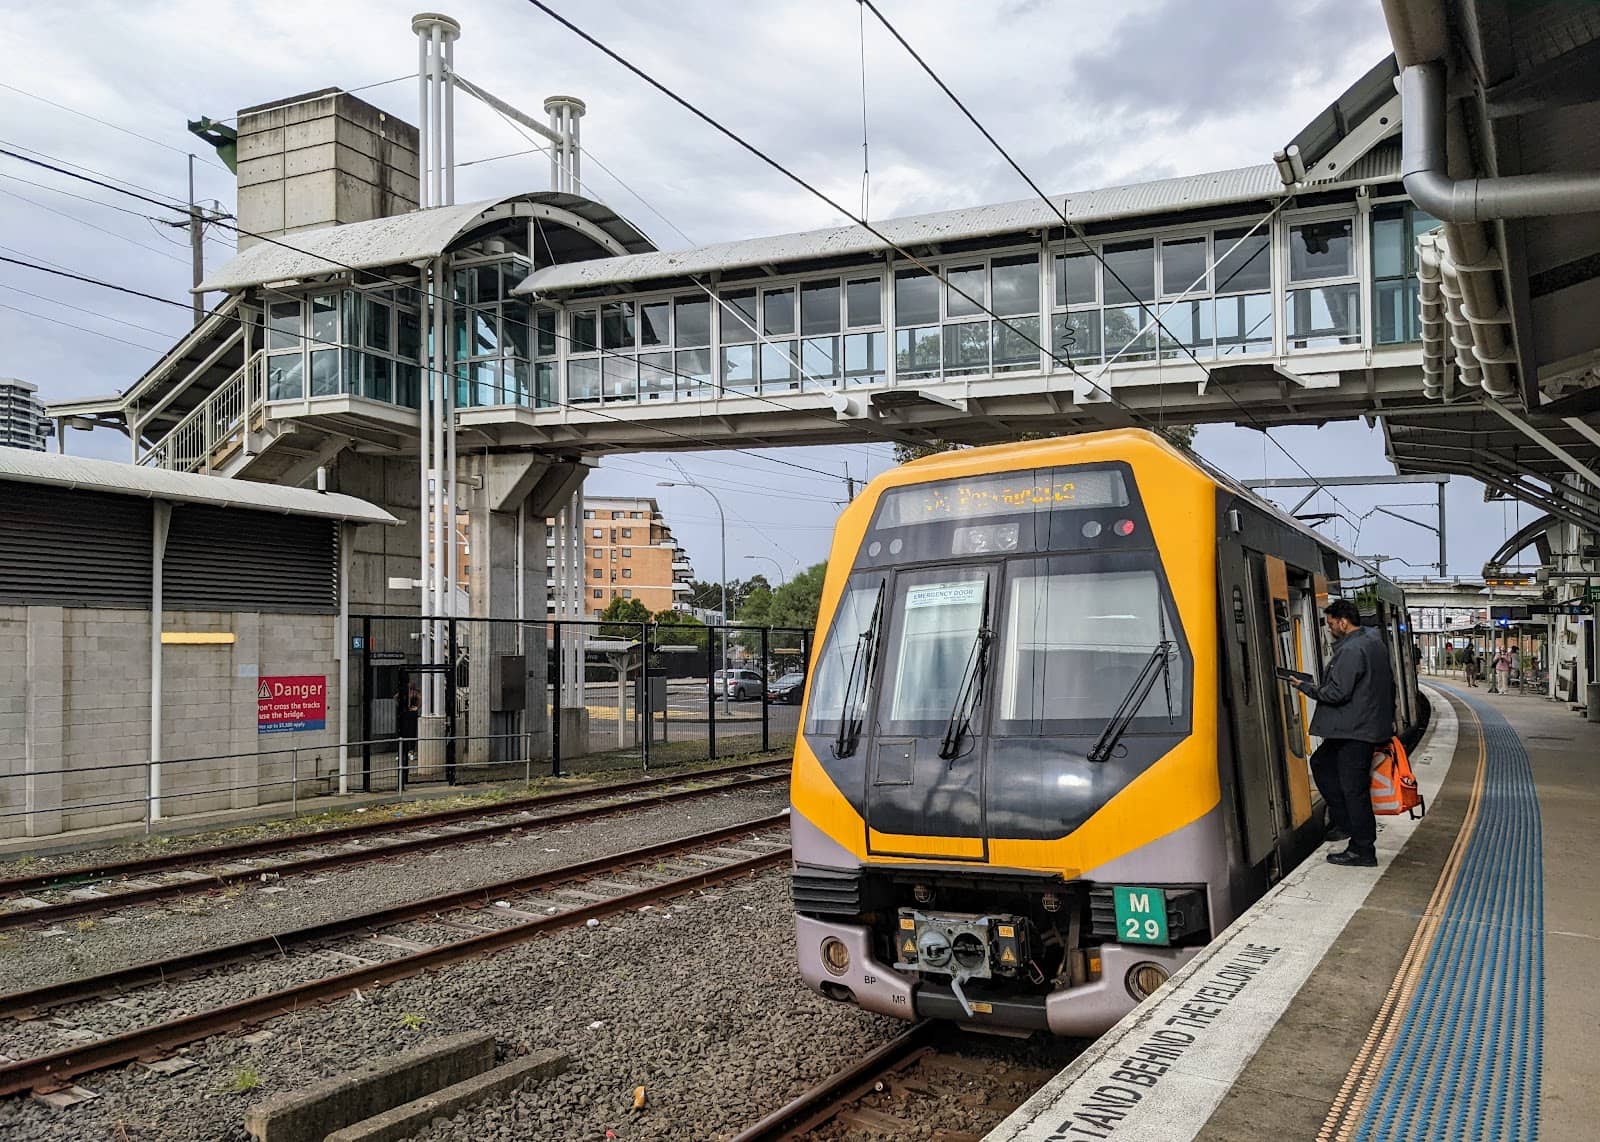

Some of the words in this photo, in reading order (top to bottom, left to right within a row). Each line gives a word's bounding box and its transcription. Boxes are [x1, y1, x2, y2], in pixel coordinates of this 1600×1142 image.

[913, 590, 952, 600] EMERGENCY
[954, 588, 974, 597] DOOR
[274, 682, 323, 699] Danger
[257, 703, 273, 711] on't
[274, 703, 290, 711] cross
[291, 701, 302, 709] the
[303, 700, 321, 709] tracks
[272, 711, 282, 719] the
[283, 710, 305, 720] bridge.
[1129, 893, 1150, 913] M
[1125, 918, 1160, 940] 29
[1232, 943, 1281, 966] LINE
[864, 975, 877, 985] BP
[1188, 962, 1262, 1006] YELLOW
[892, 994, 906, 1005] MR
[1164, 1003, 1223, 1029] THE
[1109, 1029, 1196, 1088] BEHIND
